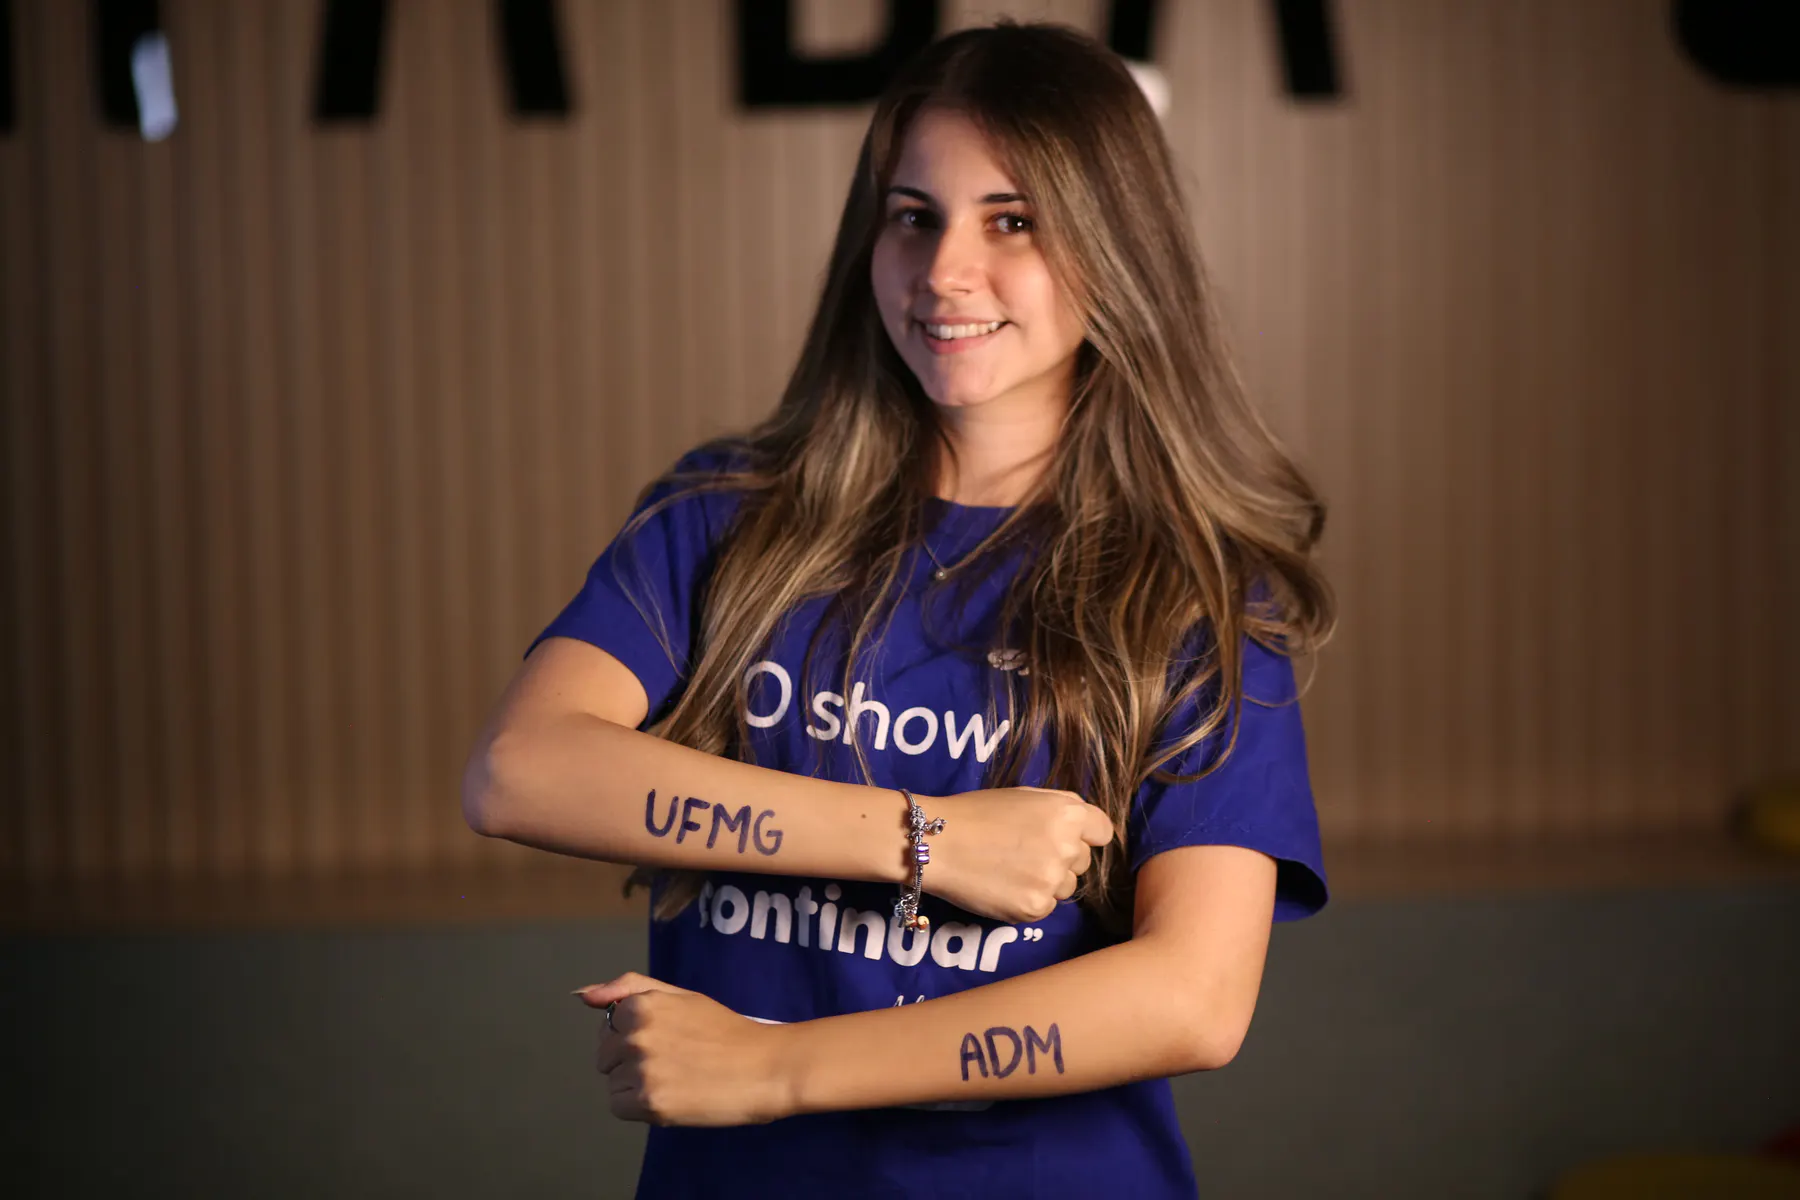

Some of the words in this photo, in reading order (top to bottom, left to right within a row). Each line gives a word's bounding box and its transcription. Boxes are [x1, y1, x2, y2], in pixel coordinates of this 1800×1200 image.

[742, 661, 792, 728] O
[806, 682, 1011, 763] show
[645, 789, 784, 856] UFMG
[960, 1023, 1065, 1082] ADM
